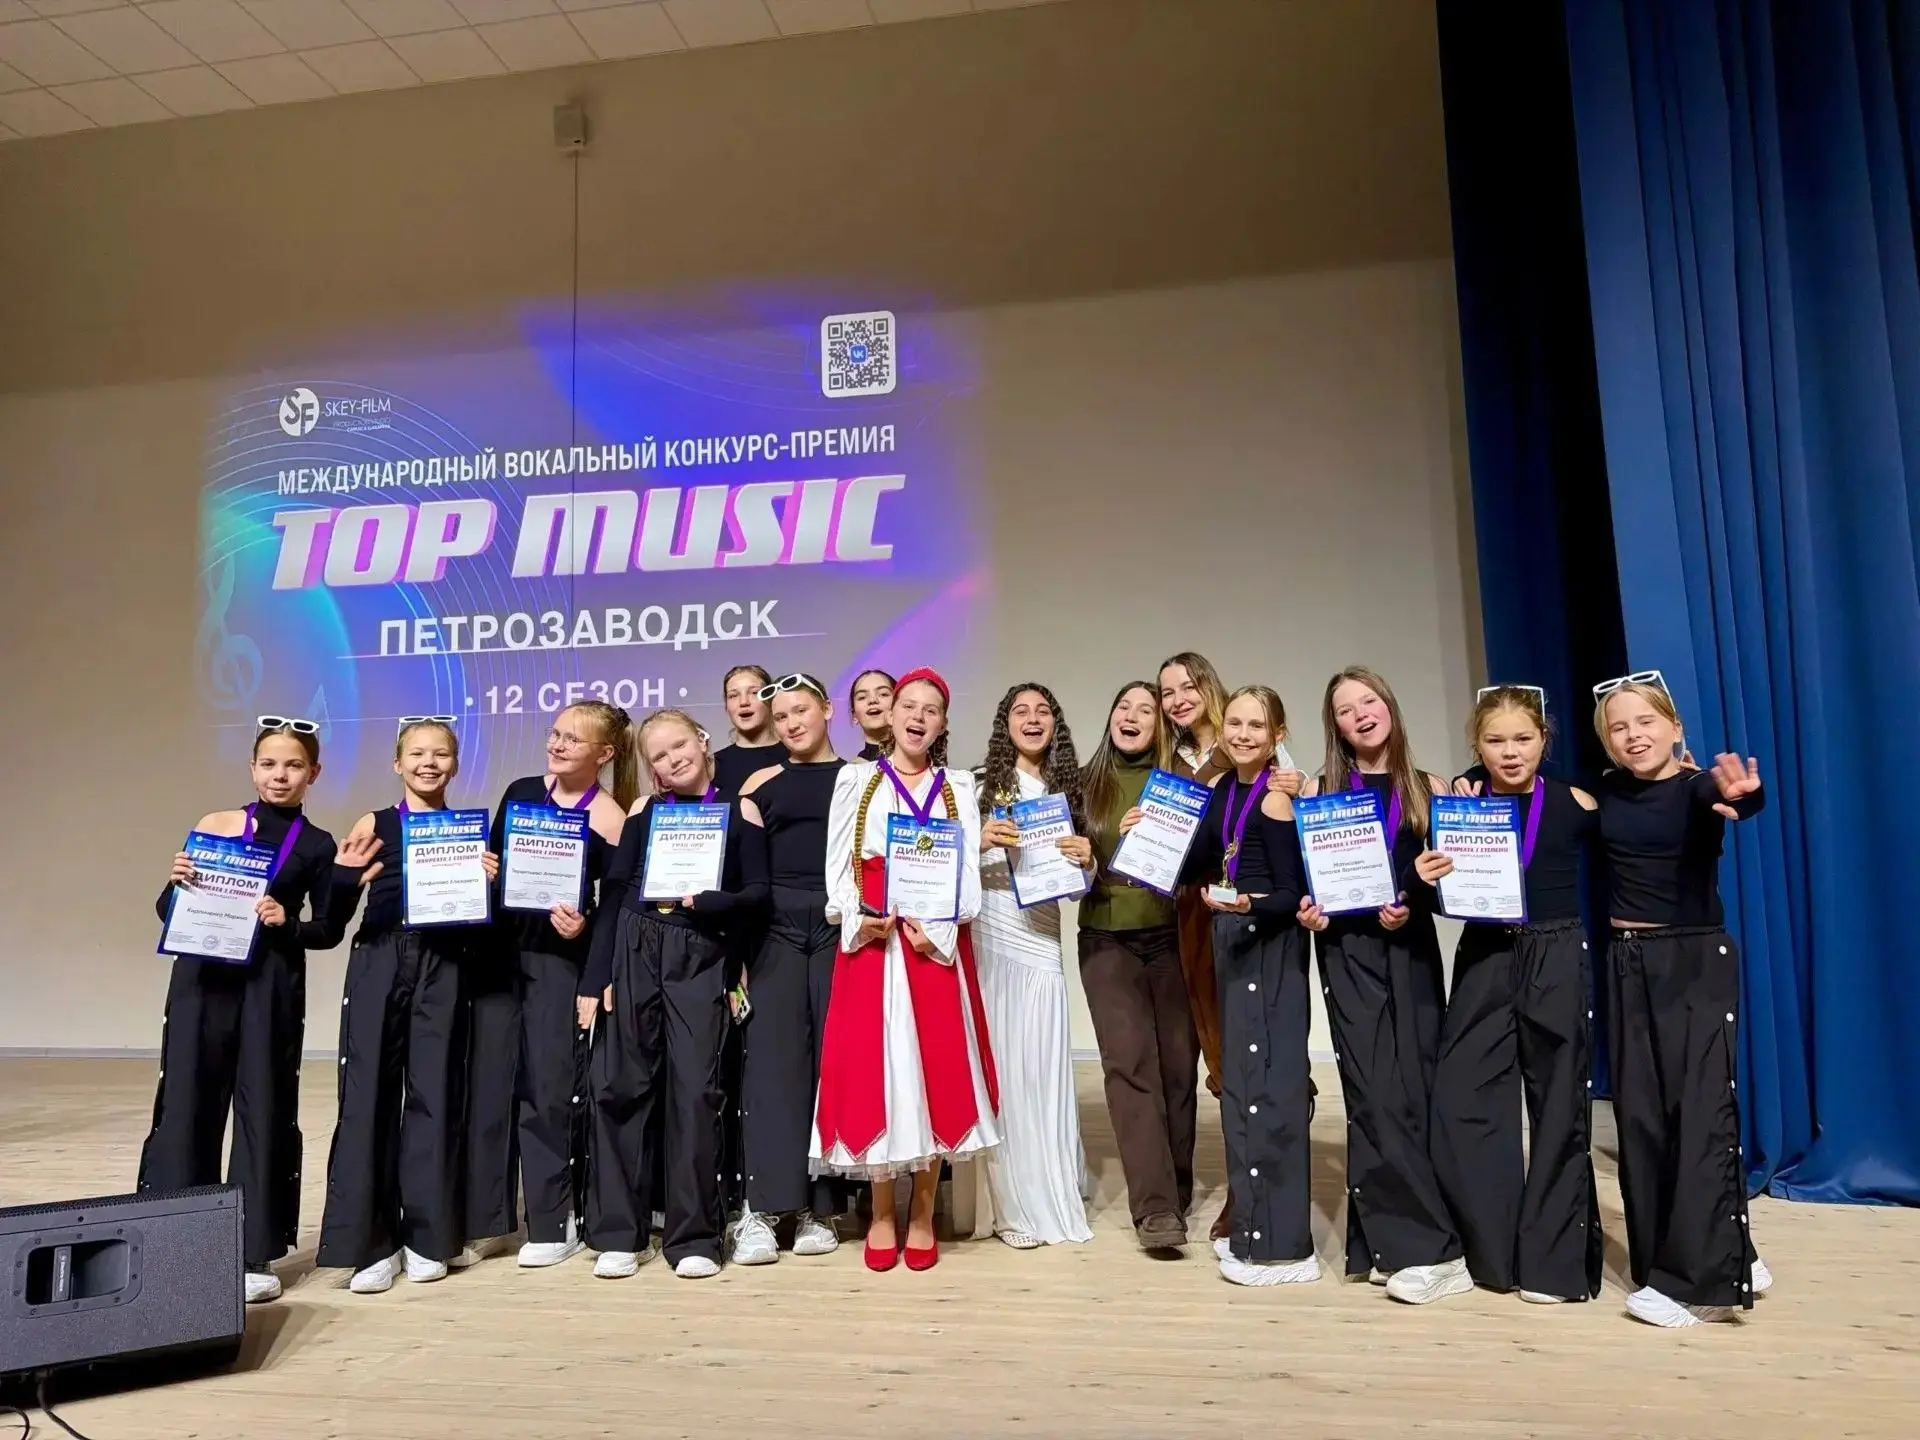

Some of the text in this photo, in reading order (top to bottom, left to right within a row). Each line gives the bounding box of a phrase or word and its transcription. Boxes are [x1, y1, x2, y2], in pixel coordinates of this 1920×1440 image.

[324, 397, 391, 417] SKEY-FILM
[277, 424, 895, 496] МЕЖДУНАРОДНЫЙ ВОКАЛЬНЫЙ КОНКУРС-ПРЕМИЯ
[272, 474, 906, 590] TOP MUSIC
[379, 599, 780, 656] ПЕТРОЗАВОДСК
[485, 678, 665, 714] 12 СЕЗОН
[1146, 804, 1194, 827] ДИПЛОМ
[659, 832, 716, 841] ДИПЛОМ
[1021, 825, 1064, 841] ИПЛОМ
[1312, 826, 1375, 844] ДИПЛОМ
[1444, 834, 1508, 845] ДИПЛОМ
[415, 844, 478, 857] ДИПЛОМ
[515, 837, 576, 850] ДИПЛОМ
[194, 872, 259, 890] ДИПЛОМ
